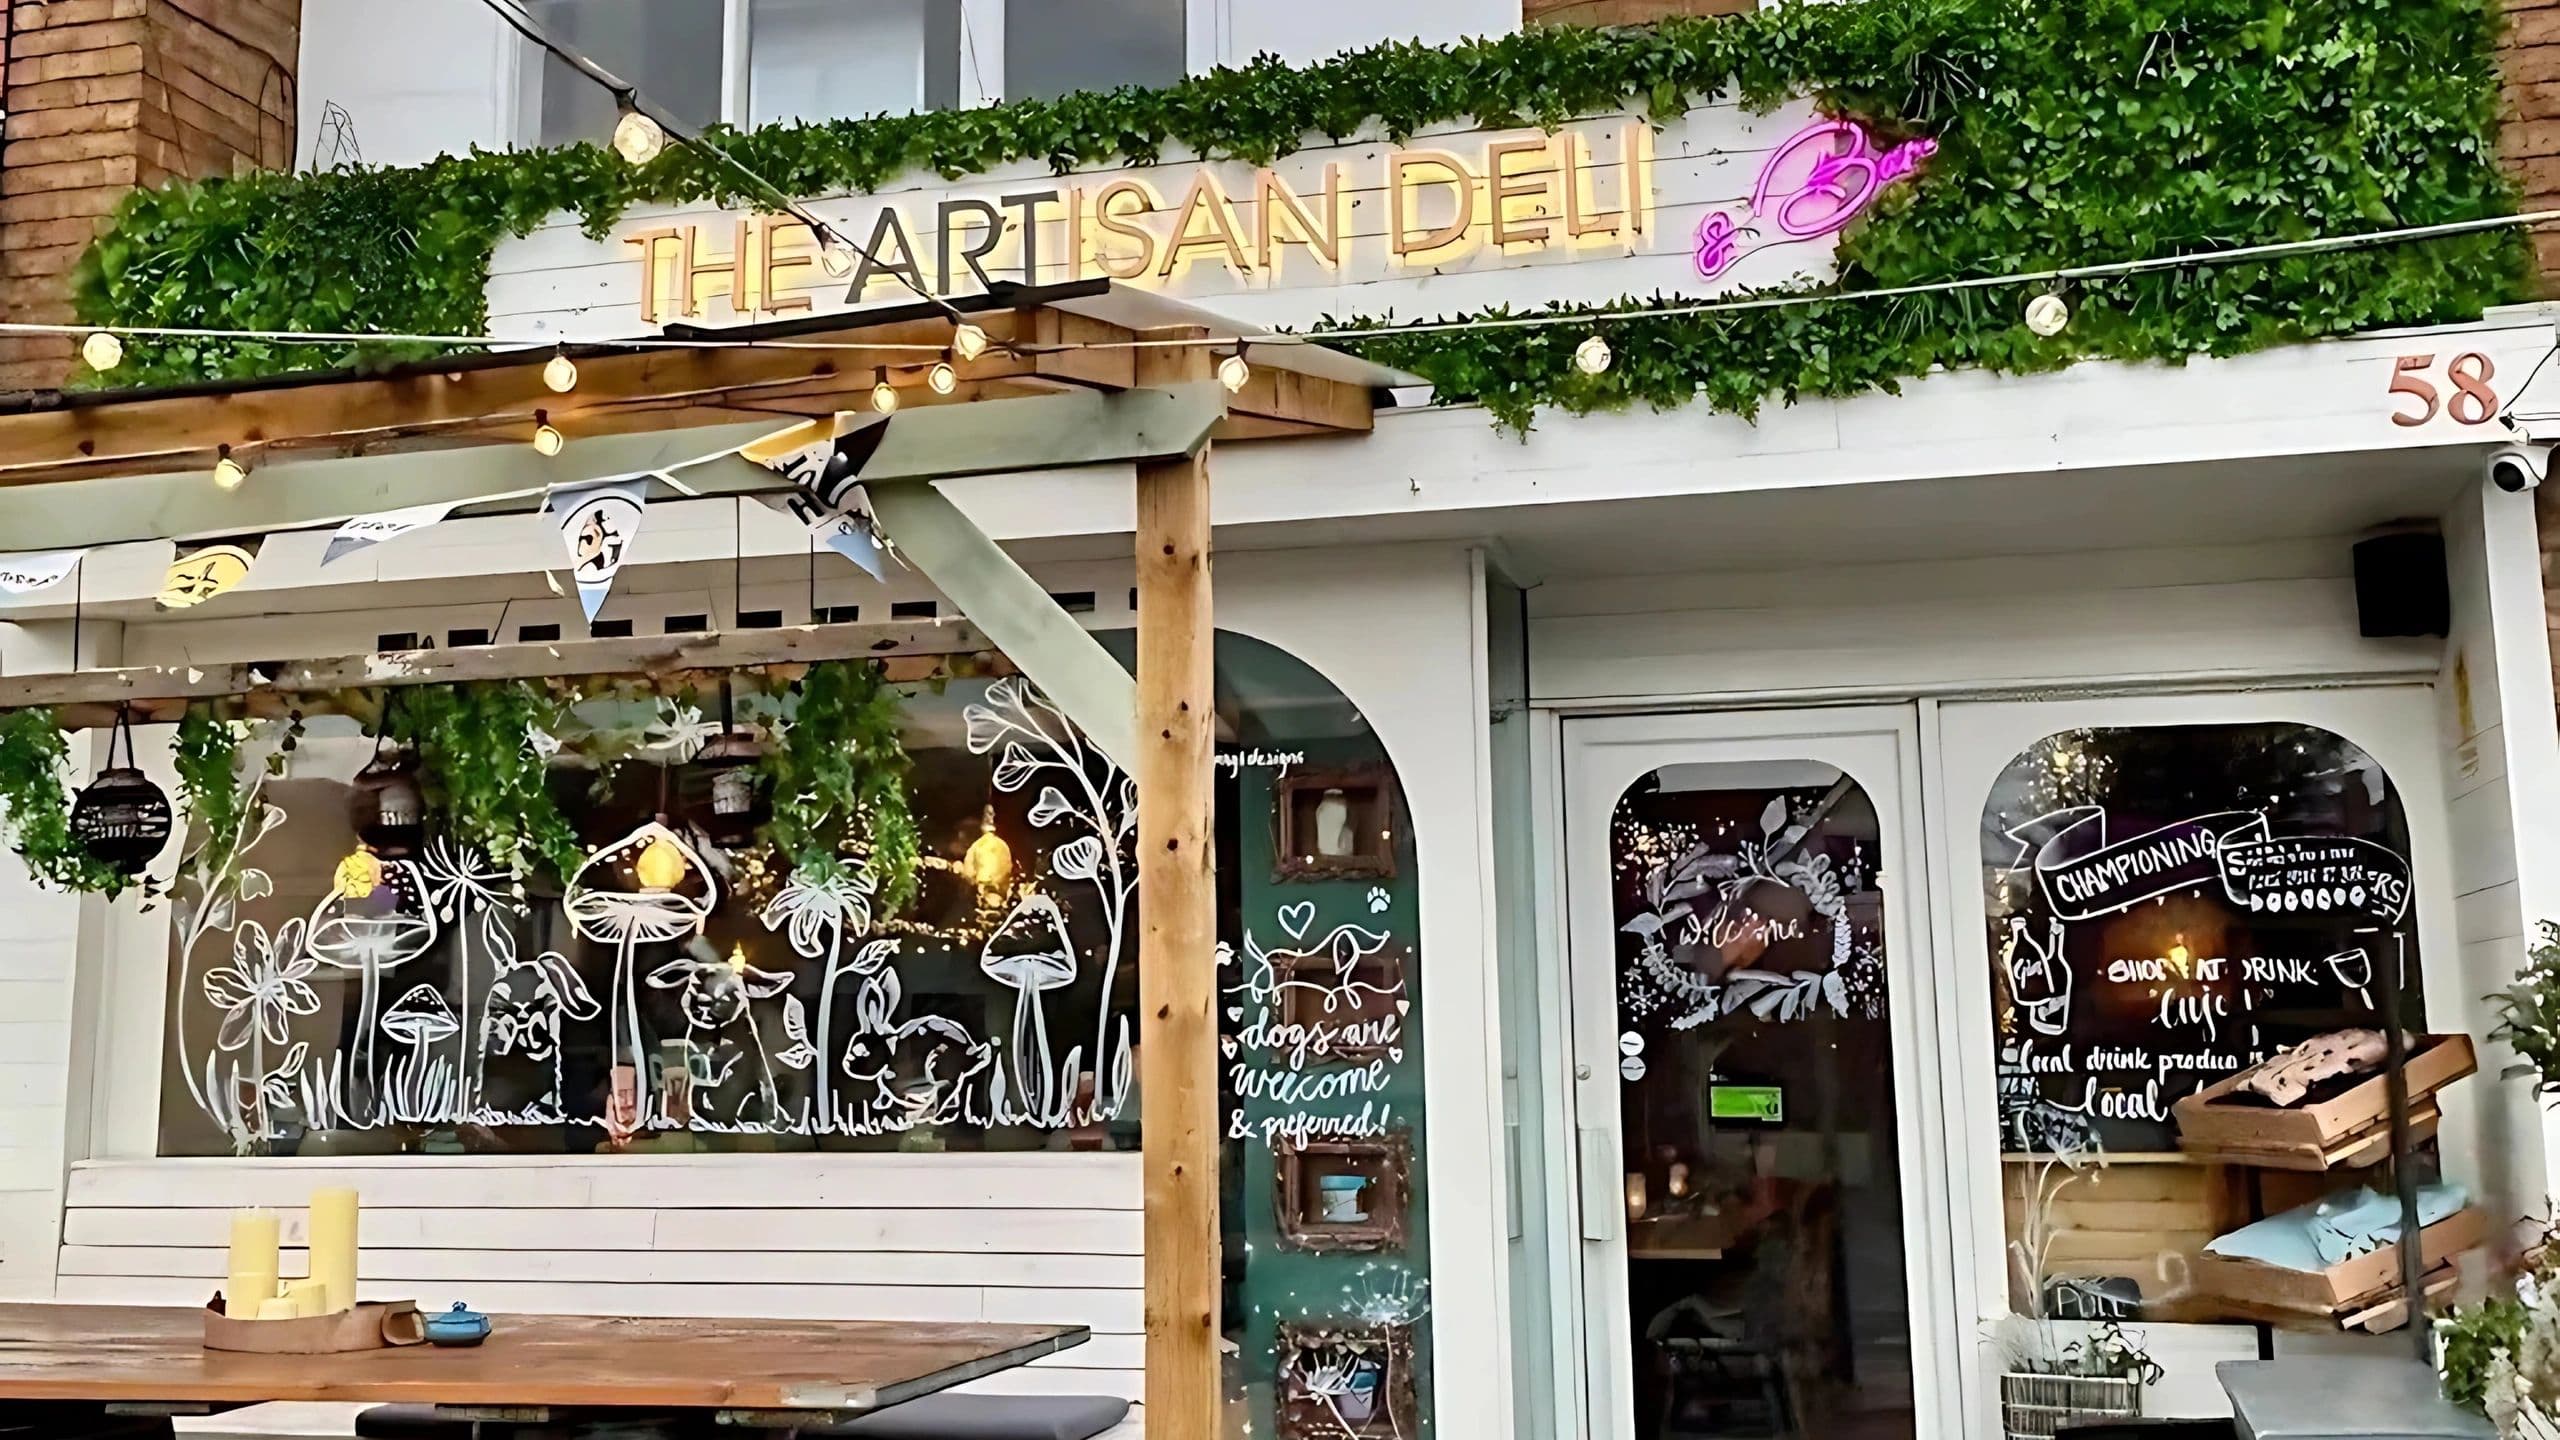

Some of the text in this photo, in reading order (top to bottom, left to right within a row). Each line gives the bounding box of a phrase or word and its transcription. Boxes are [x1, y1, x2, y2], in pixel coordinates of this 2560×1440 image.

[623, 120, 1642, 322] THE ARTISAN DELI
[2388, 352, 2499, 427] 58
[2055, 828, 2217, 903] CHAMPIONING
[1237, 1006, 1401, 1072] dogs are
[1229, 1058, 1391, 1105] welcome
[2046, 1076, 2168, 1123] local
[1228, 1100, 1391, 1151] & preferred!
